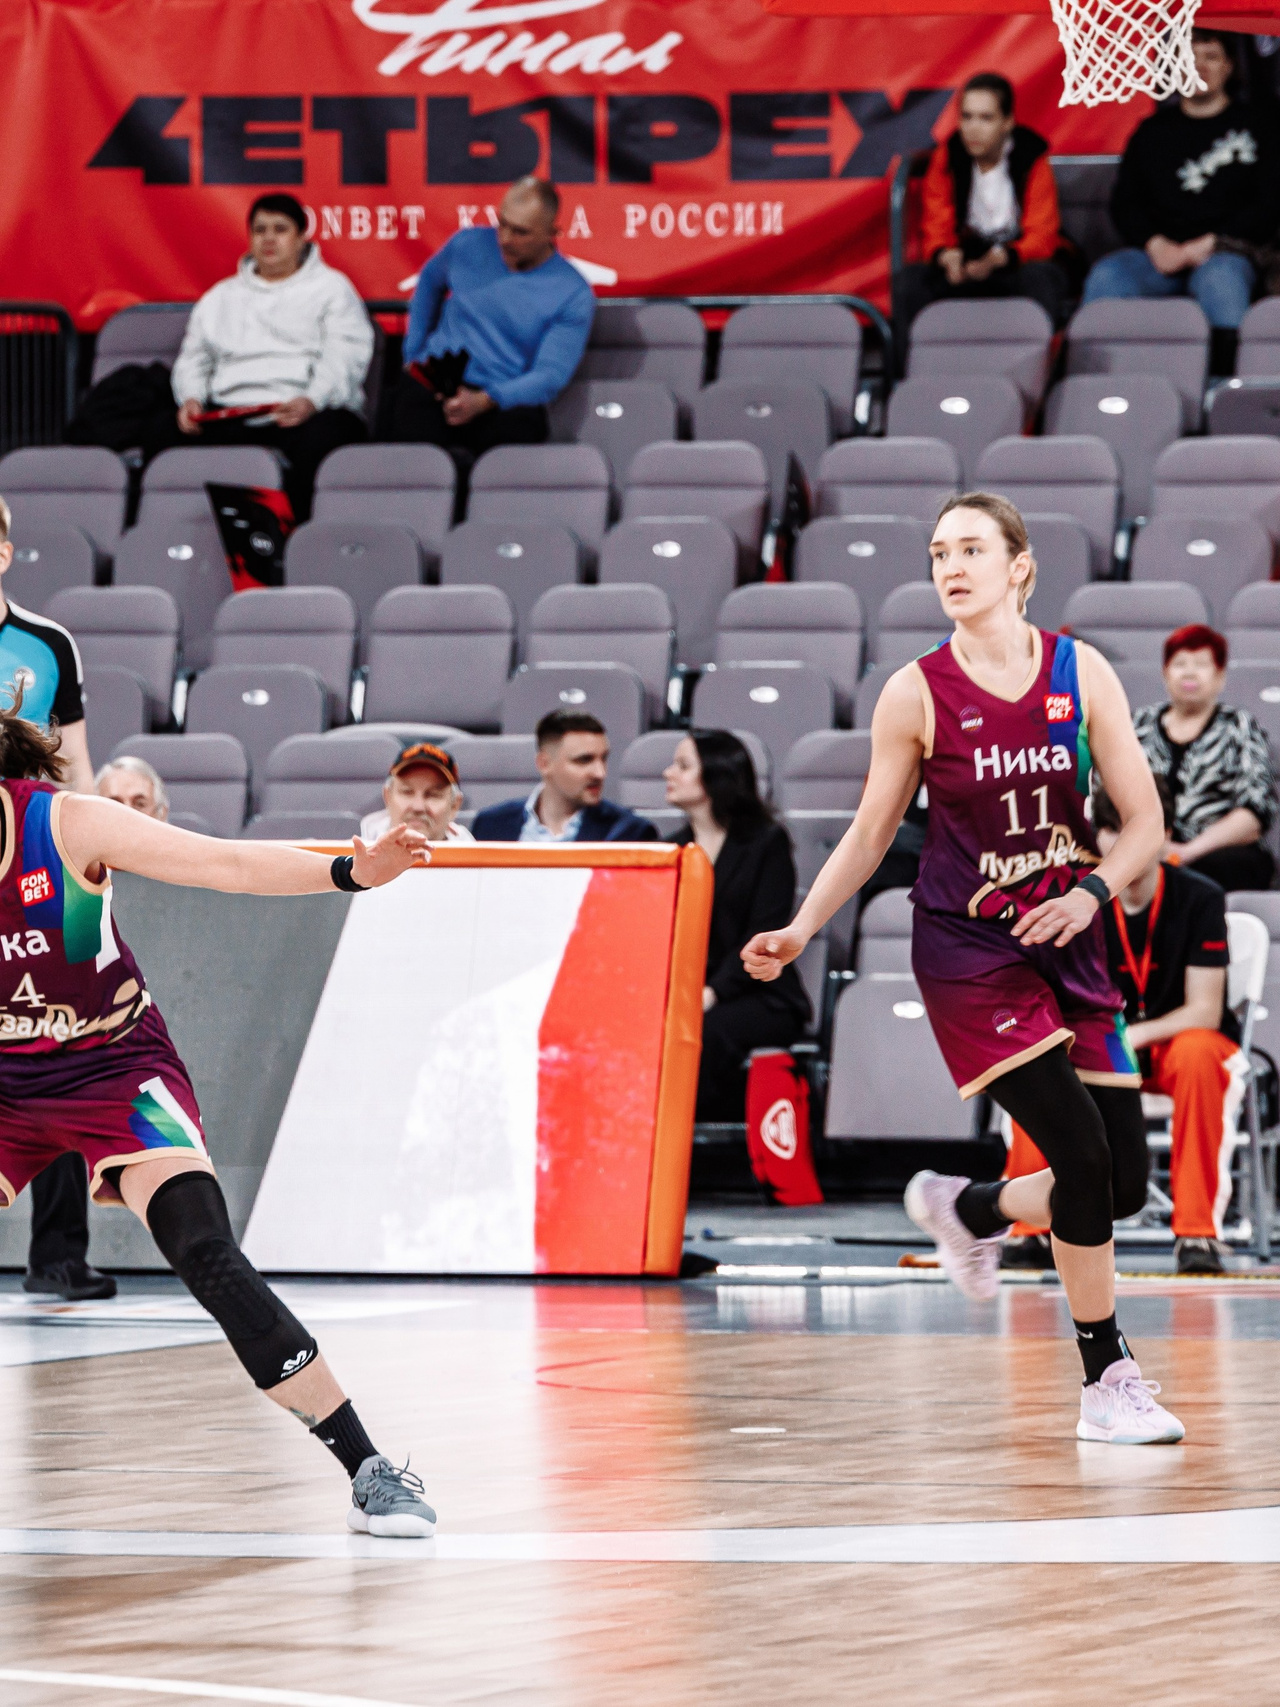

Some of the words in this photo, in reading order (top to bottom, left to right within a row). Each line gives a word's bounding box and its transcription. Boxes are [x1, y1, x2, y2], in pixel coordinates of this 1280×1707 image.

[624, 201, 785, 239] РОССИИ
[974, 744, 1072, 781] Ника
[999, 785, 1054, 836] 11
[21, 870, 47, 891] FON
[23, 882, 50, 903] BET
